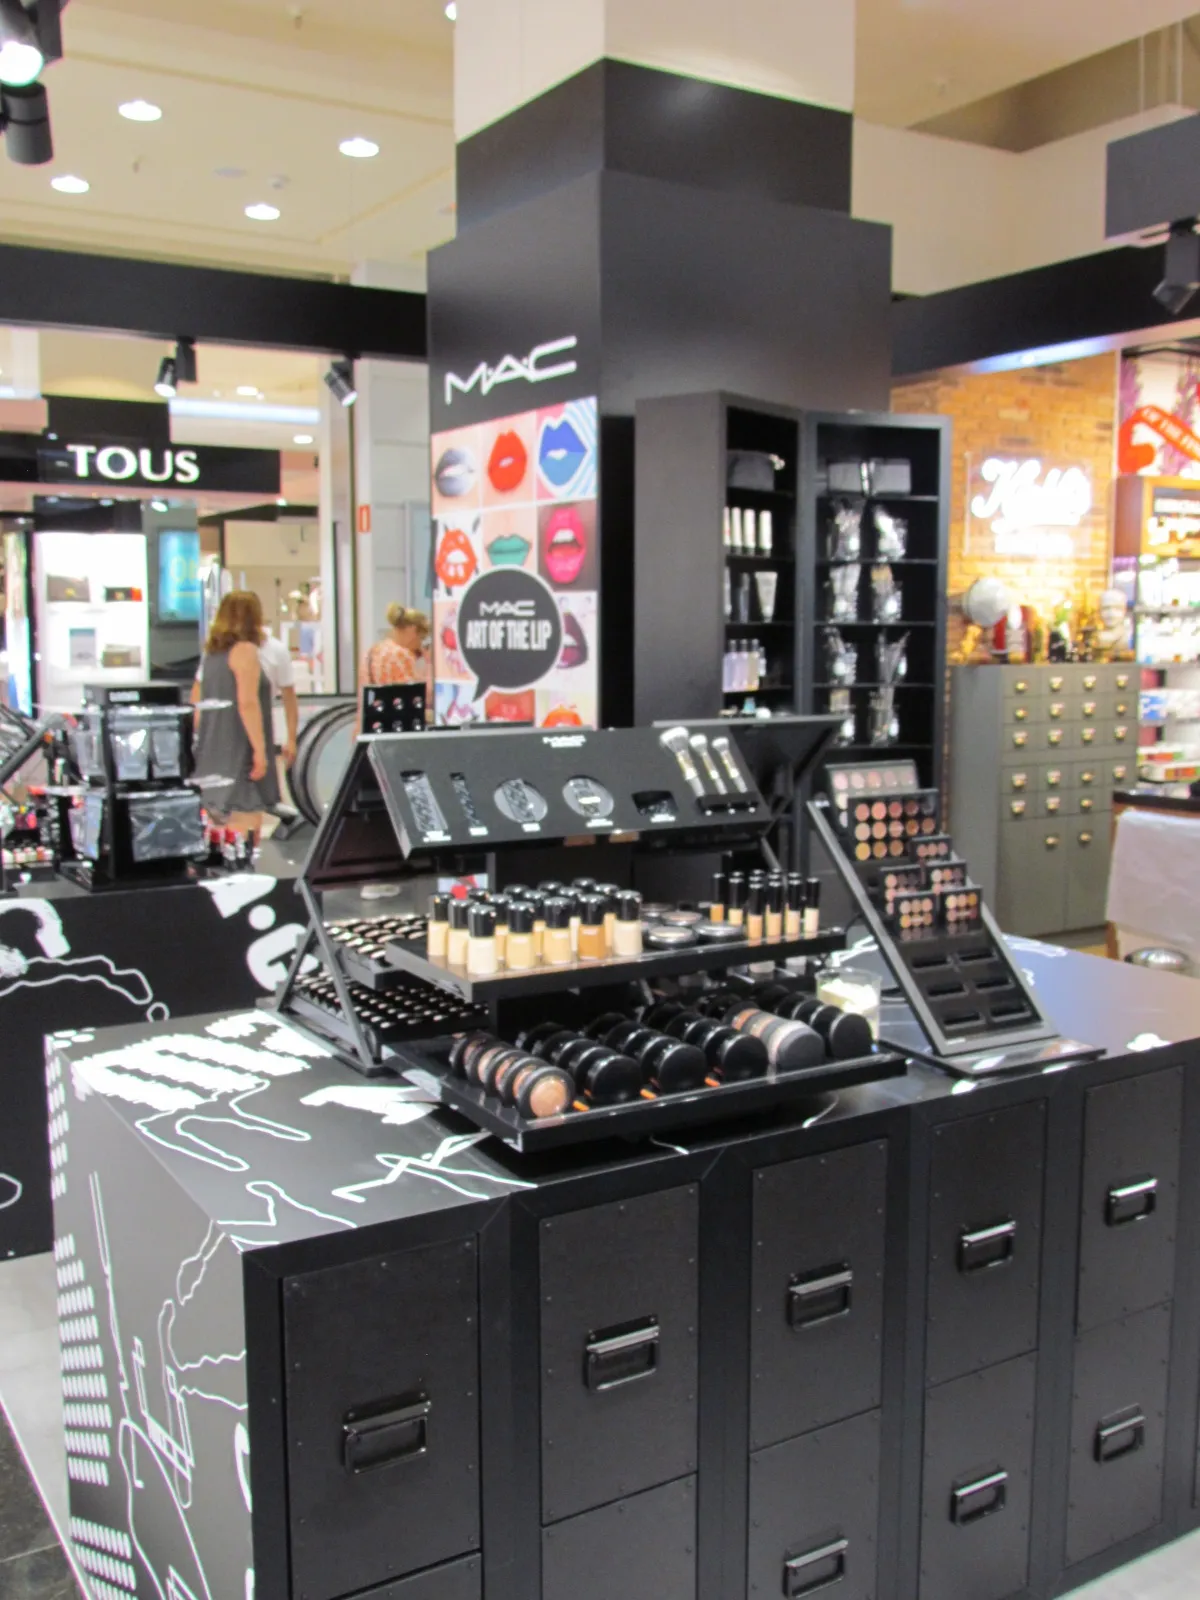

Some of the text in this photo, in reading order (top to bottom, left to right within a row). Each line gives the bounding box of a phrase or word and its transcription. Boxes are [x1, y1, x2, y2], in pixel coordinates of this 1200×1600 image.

[67, 444, 200, 483] TOUS
[466, 619, 552, 651] ART OF THE LIP
